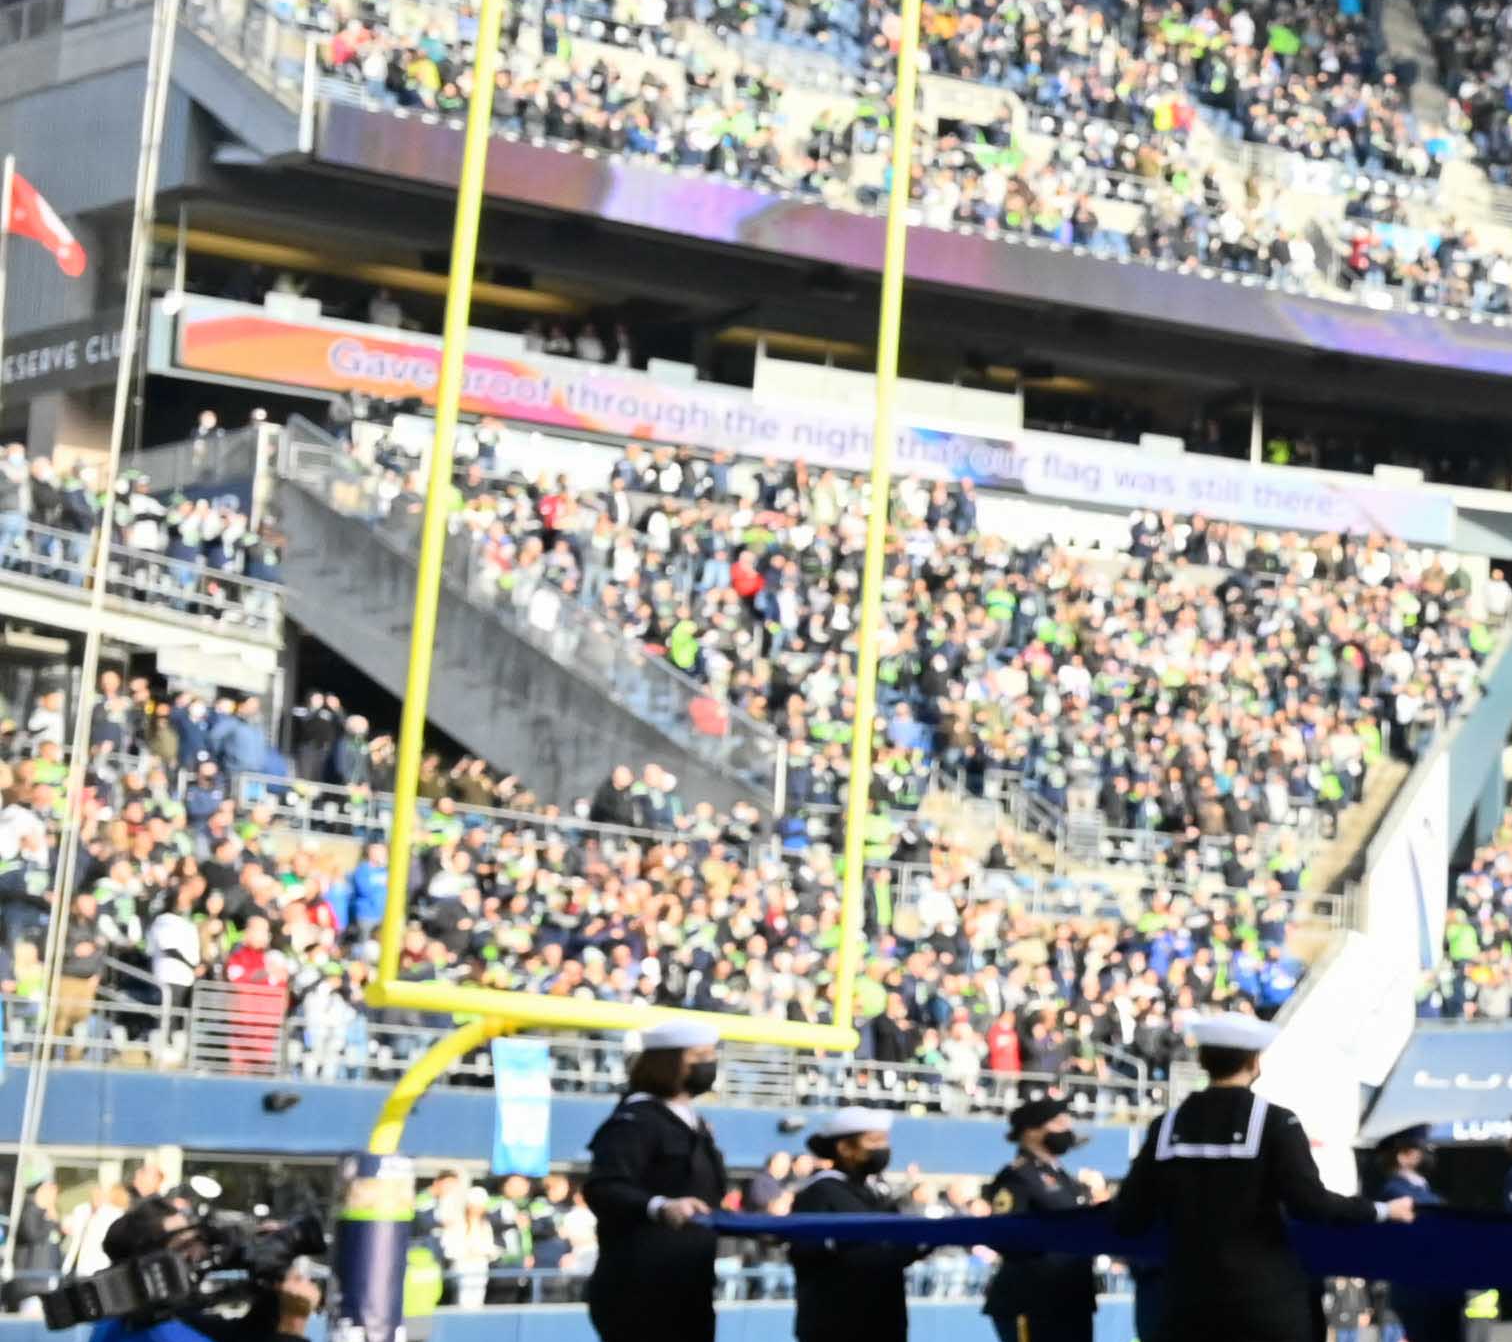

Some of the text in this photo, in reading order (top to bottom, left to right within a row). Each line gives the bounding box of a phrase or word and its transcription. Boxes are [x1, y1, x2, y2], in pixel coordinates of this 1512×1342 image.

[329, 340, 434, 389] Gave
[566, 380, 710, 428] through
[723, 405, 779, 439] the
[792, 422, 874, 458] nigh
[1041, 453, 1102, 495] flag
[1114, 470, 1175, 496] was
[1188, 473, 1244, 506] still
